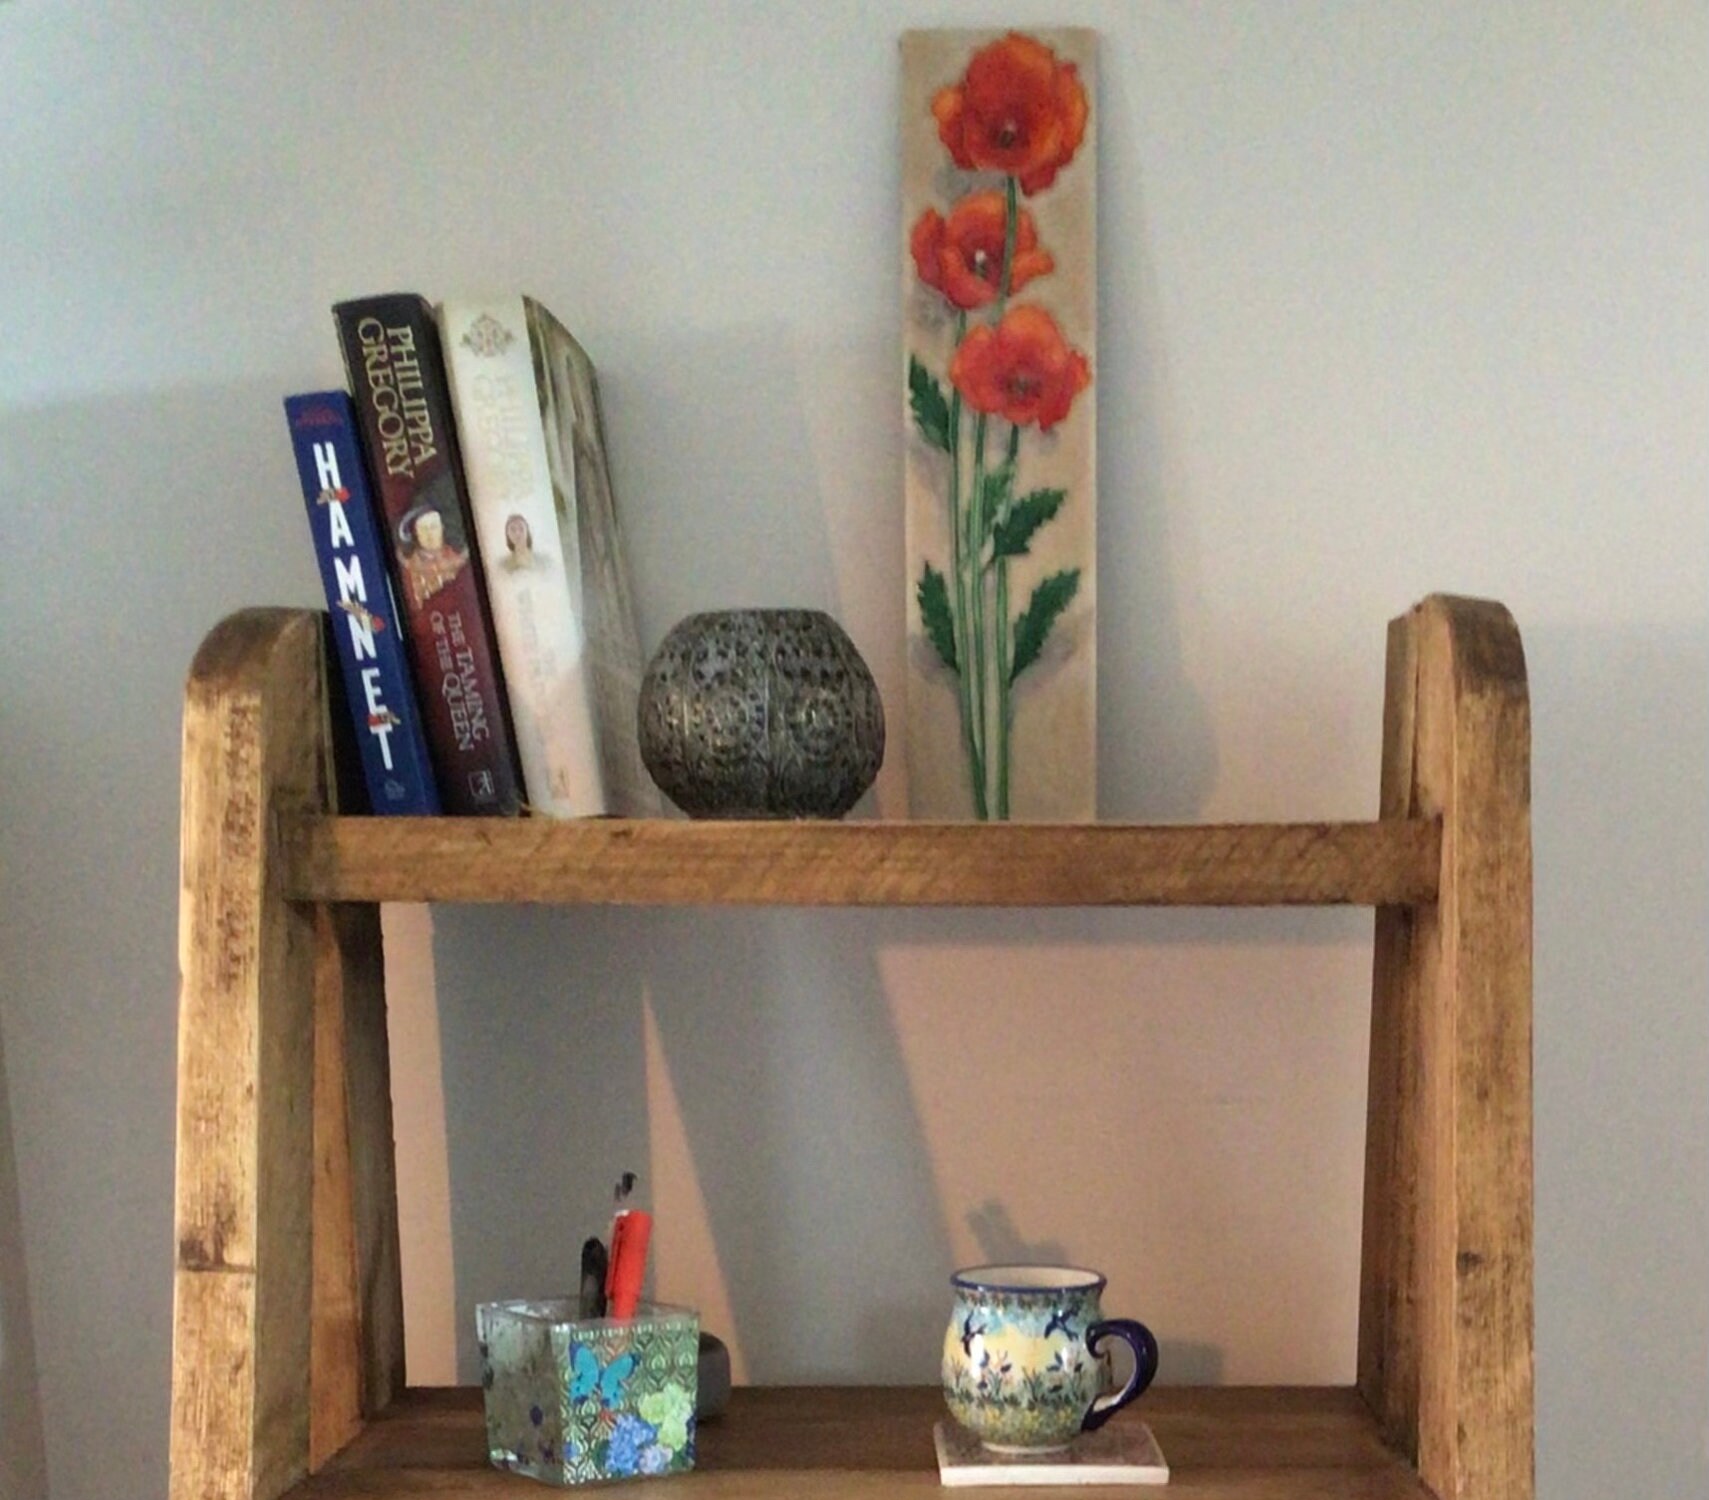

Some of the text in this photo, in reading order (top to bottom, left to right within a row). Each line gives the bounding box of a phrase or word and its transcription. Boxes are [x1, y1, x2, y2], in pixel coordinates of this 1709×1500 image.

[358, 317, 414, 478] GREGORY
[387, 325, 437, 466] PHILIPPA
[313, 441, 393, 771] HAMNET
[447, 610, 489, 740] THE TAMING
[430, 610, 474, 750] OF THE QUEEN
